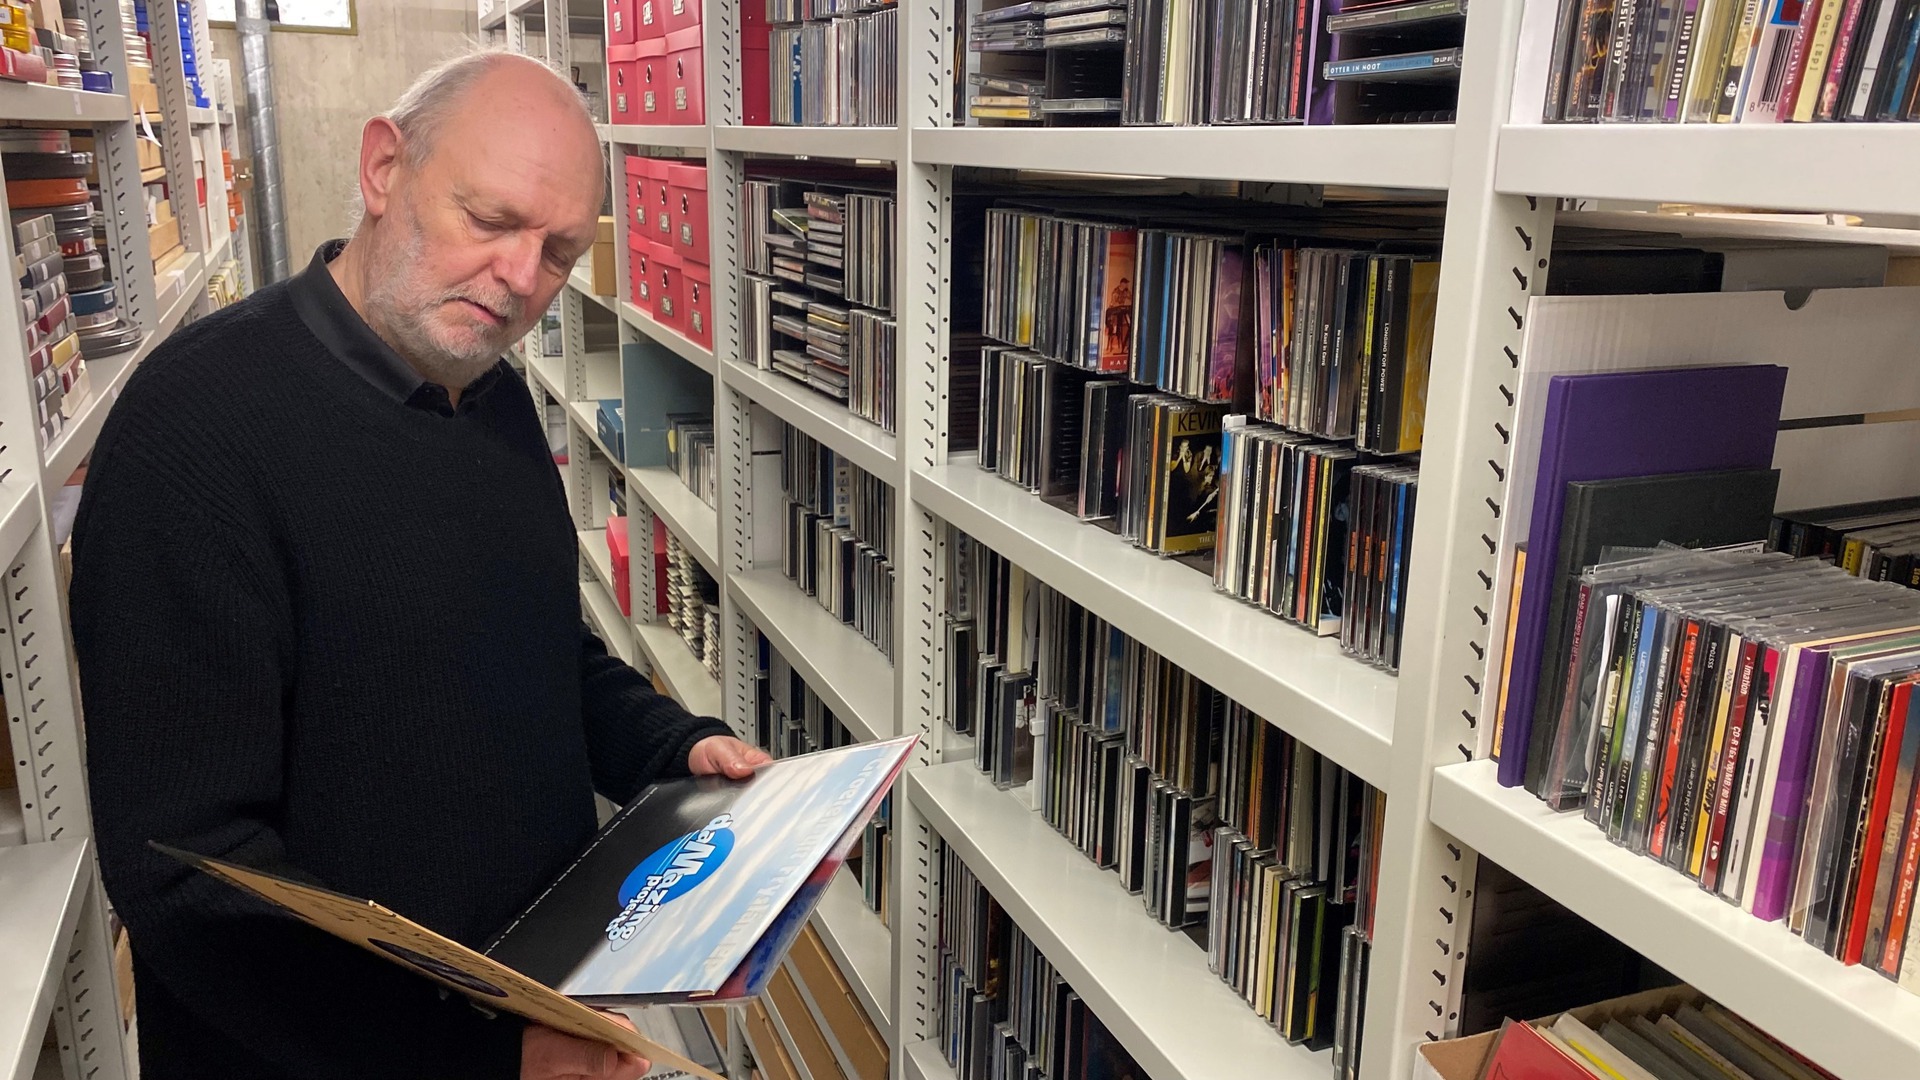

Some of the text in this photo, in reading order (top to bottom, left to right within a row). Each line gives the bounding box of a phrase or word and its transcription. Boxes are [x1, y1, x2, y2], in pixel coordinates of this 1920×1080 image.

[1820, 13, 1832, 36] Out
[1611, 35, 1624, 64] 1997
[1329, 65, 1349, 74] OTTER
[1860, 82, 1869, 94] EP
[1739, 664, 1753, 695] imation
[1650, 715, 1659, 729] The
[1730, 725, 1741, 745] CD-R
[1728, 746, 1737, 759] 16x
[1637, 770, 1650, 798] working
[1718, 797, 1728, 815] MIN
[1882, 810, 1904, 855] Mundane
[1908, 841, 1917, 860] van
[1905, 862, 1915, 875] de
